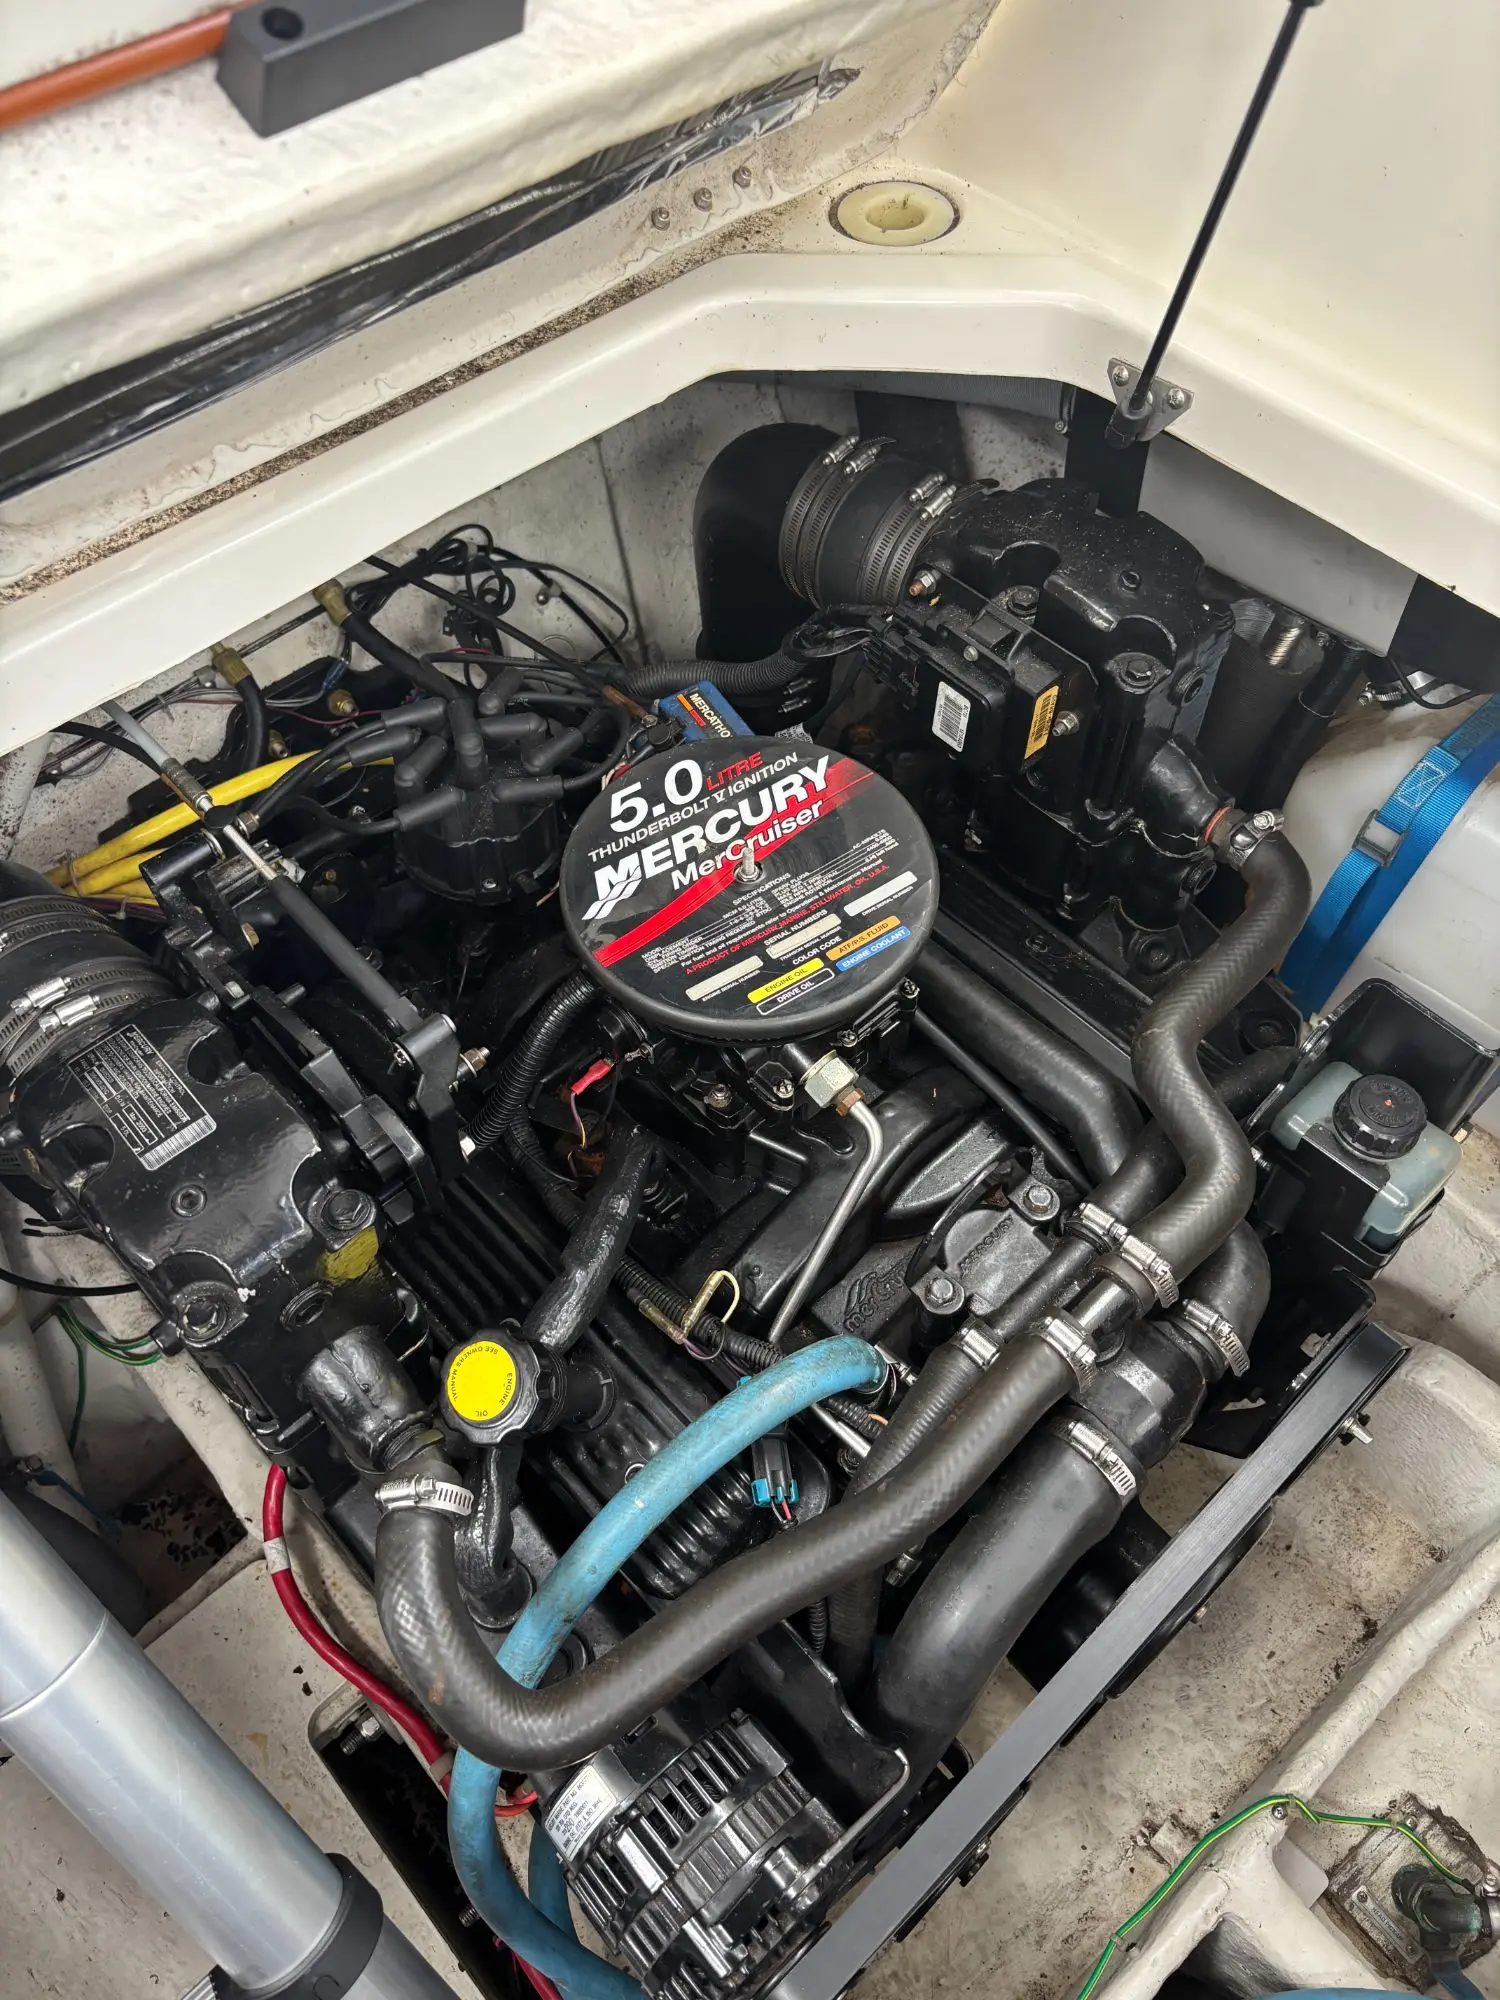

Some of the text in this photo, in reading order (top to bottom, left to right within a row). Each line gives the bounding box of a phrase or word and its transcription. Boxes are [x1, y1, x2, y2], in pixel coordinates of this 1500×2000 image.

[690, 692, 732, 738] MERCATHO
[588, 752, 799, 863] THUNDERBOLT V IGNITION
[610, 752, 763, 833] 5.0 LITRE
[594, 755, 829, 902] MERCURY
[671, 800, 823, 891] MerCruiser
[732, 872, 791, 905] SPECIFICATIONS
[771, 882, 790, 894] SPARK
[790, 872, 809, 883] PLUGS
[774, 887, 789, 897] PLUG
[780, 895, 793, 903] IDLE
[793, 888, 806, 896] RPM
[813, 871, 838, 885] NEUTRAL
[783, 894, 805, 907] ENGINE
[804, 879, 832, 895] ROTATION
[808, 875, 821, 883] RPM
[681, 959, 692, 967] For
[692, 952, 704, 961] fuel
[705, 947, 717, 955] and
[725, 923, 766, 946] requirements
[764, 916, 779, 925] refer
[786, 894, 819, 914] Operations
[823, 871, 862, 893] Maintenance
[860, 858, 882, 872] Manual
[862, 906, 876, 915] DRIVE
[892, 886, 913, 898] NUMBER
[641, 946, 662, 958] MODEL
[722, 909, 738, 918] MCM
[746, 896, 762, 906] LITRE
[692, 948, 730, 971] PRODUCT
[728, 943, 741, 952] OF
[740, 924, 779, 946] MERCURY
[777, 907, 810, 927] MARINE,
[808, 883, 855, 910] STILLWATER,
[763, 908, 828, 945] SERIAL NUMBERS
[780, 926, 841, 960] TRANSOM SERIAL NUMBER
[837, 922, 889, 953] ATF/P.S. FLUID
[644, 937, 689, 962] DISPLACEMENT
[650, 954, 676, 969] IGNITION
[677, 943, 697, 956] TIMING
[653, 920, 755, 973] SPECIAL IGNITION TIMING REQUIRED
[661, 946, 681, 958] FIRING
[681, 936, 702, 948] ORDER
[792, 936, 841, 964] COLOR CODE
[841, 929, 907, 967] ENGINE COOLANT
[702, 969, 760, 1001] ENGINE SERIAL NUMBER
[764, 967, 807, 992] ENGINE OIL
[776, 980, 814, 1002] DRIVE OIL
[959, 1214, 1014, 1278] MERCURY
[450, 1345, 499, 1401] SEE OWNERS MANUAL
[474, 1372, 512, 1417] ENGINE OIL
